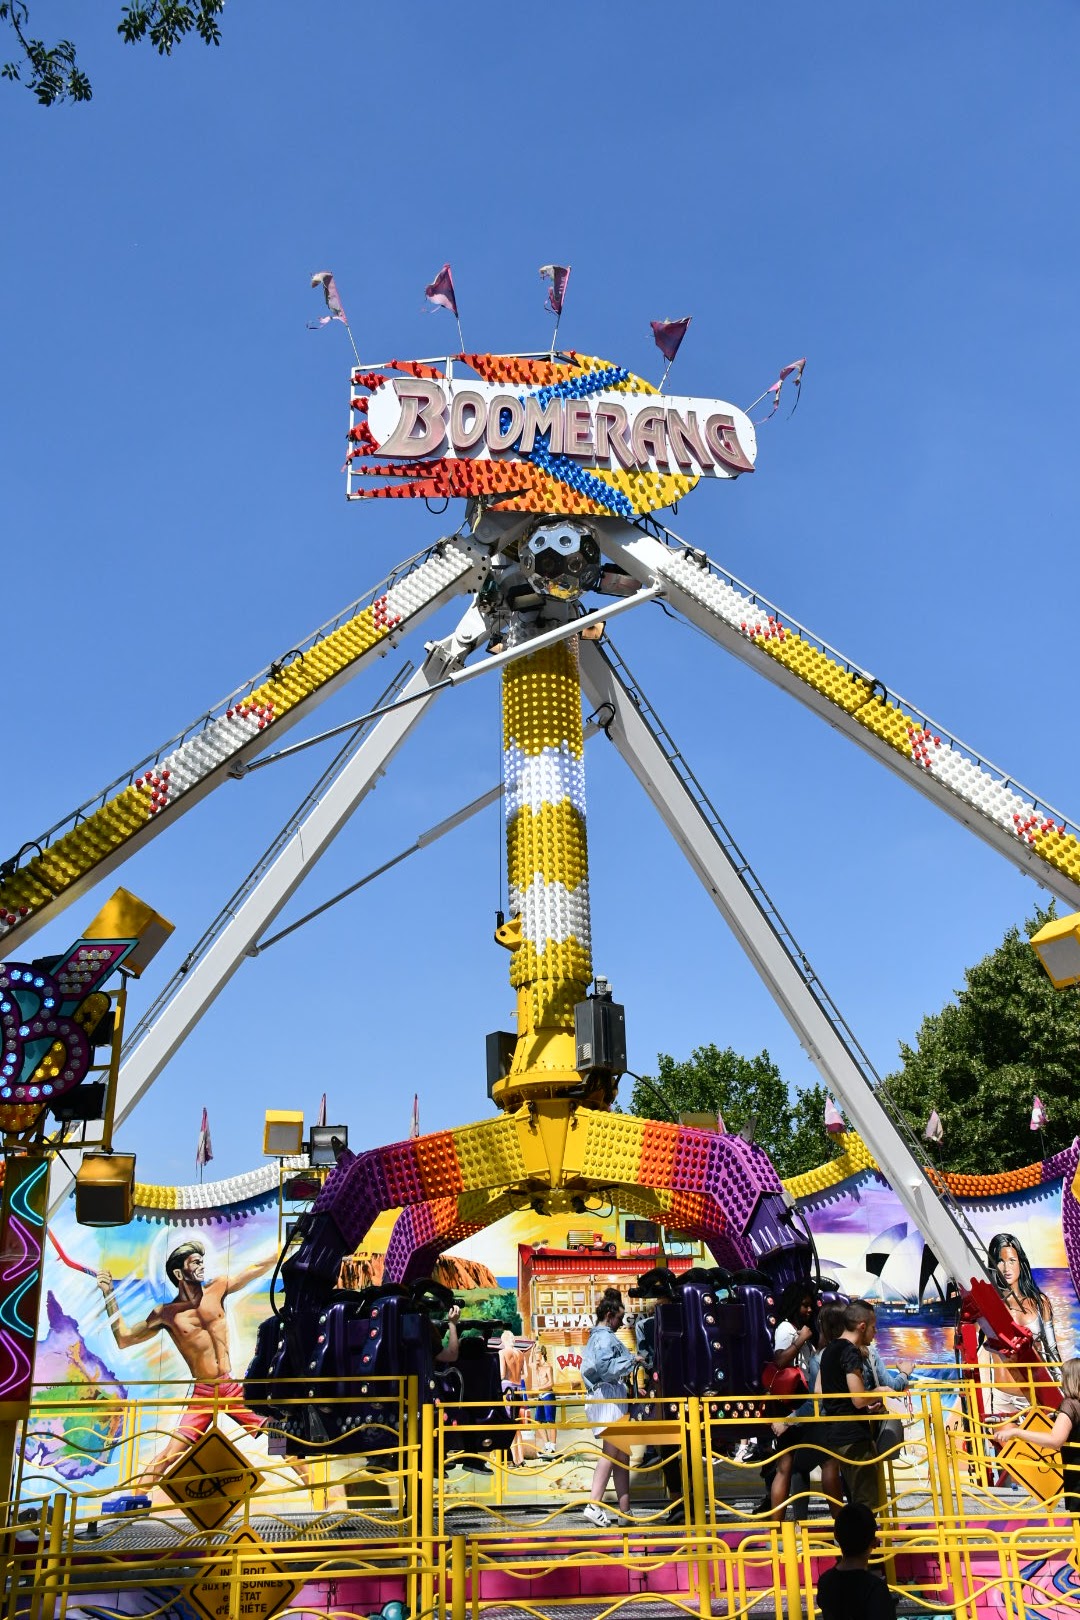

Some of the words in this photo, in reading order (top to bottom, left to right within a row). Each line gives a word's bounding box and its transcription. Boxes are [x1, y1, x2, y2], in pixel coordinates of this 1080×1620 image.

[373, 378, 756, 473] BOOMERANG
[220, 1567, 267, 1577] INRDIT
[222, 1580, 284, 1590] PSONNES
